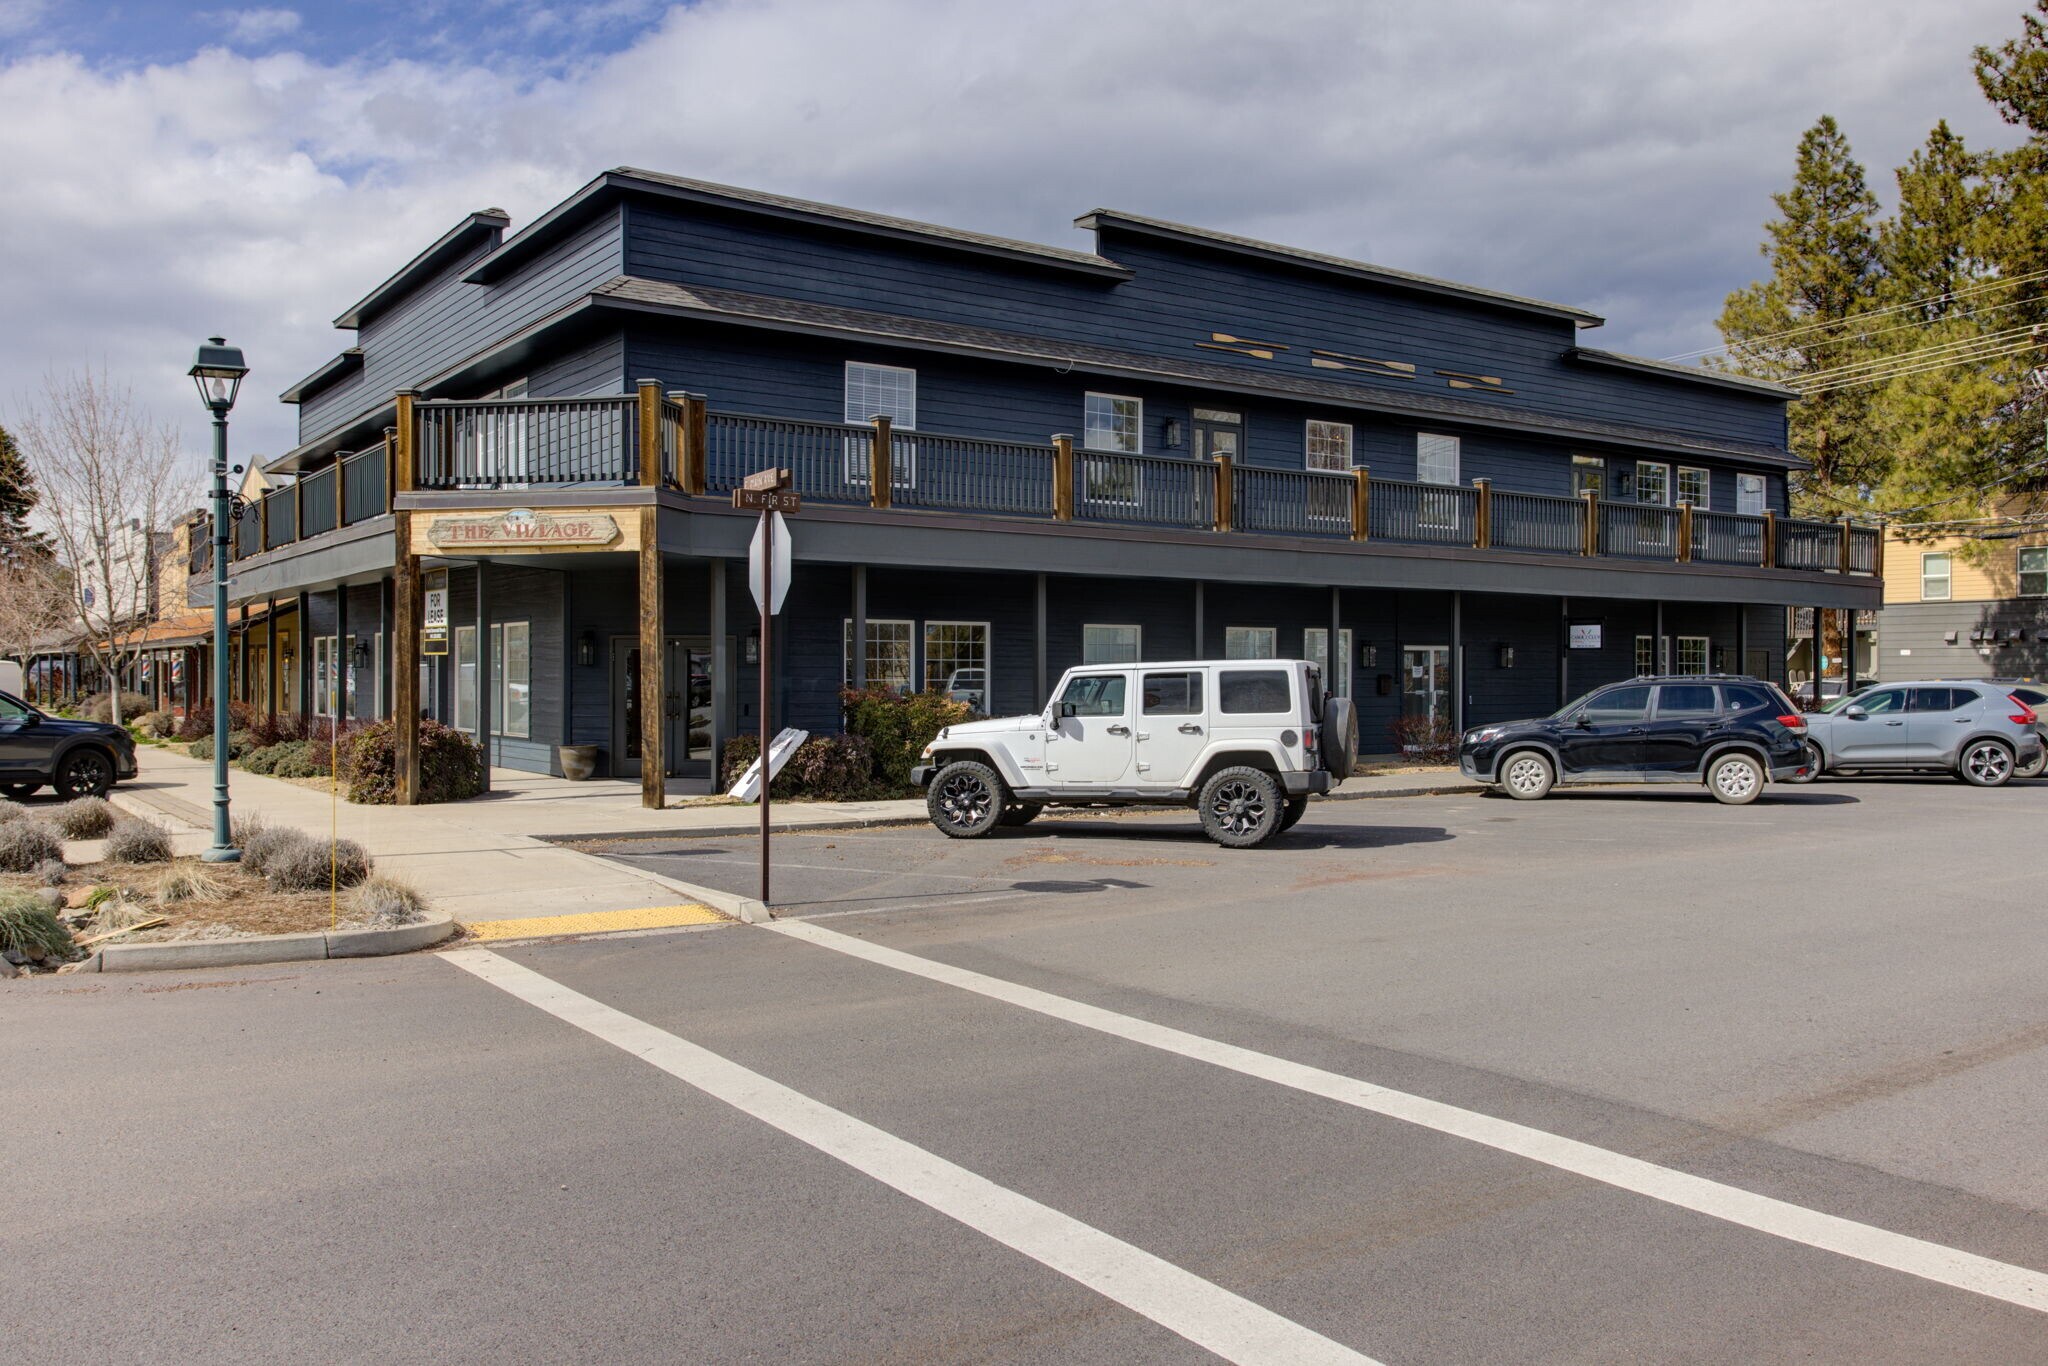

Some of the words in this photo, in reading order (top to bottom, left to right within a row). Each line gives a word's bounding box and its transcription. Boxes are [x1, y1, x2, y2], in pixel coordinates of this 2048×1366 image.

[450, 523, 494, 540] THE
[501, 523, 594, 539] VILLAGE
[430, 593, 441, 607] FOR
[428, 609, 444, 623] LEASE
